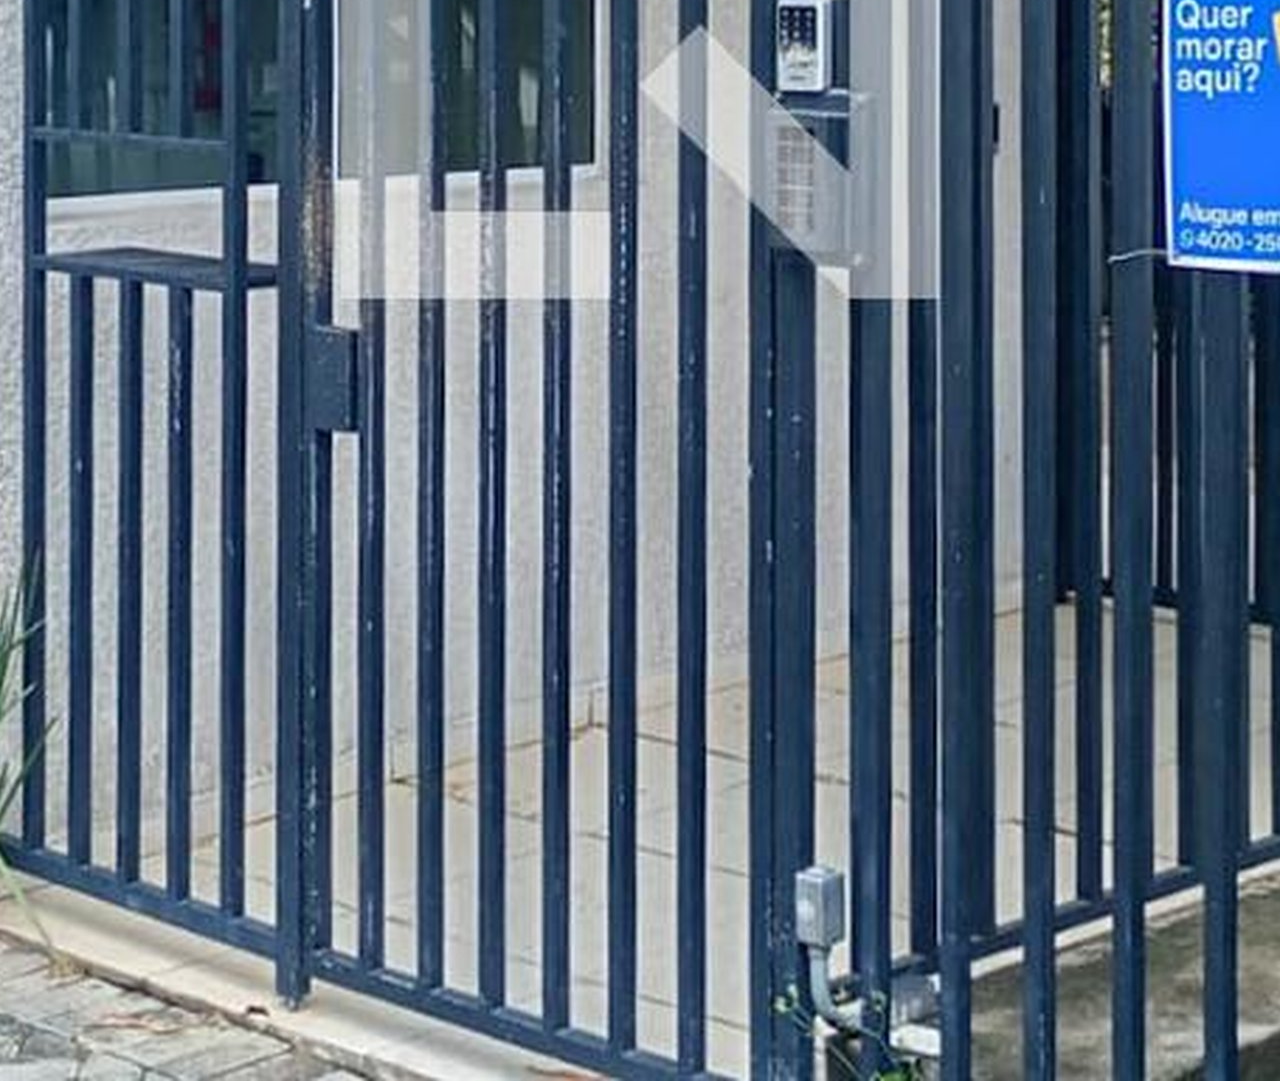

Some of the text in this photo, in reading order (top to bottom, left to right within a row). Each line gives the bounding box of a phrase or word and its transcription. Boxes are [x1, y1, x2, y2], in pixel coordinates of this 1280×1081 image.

[1176, 0, 1253, 28] Quer
[1176, 37, 1267, 61] morar
[1176, 64, 1260, 98] aqui?
[1180, 202, 1248, 229] Alugue
